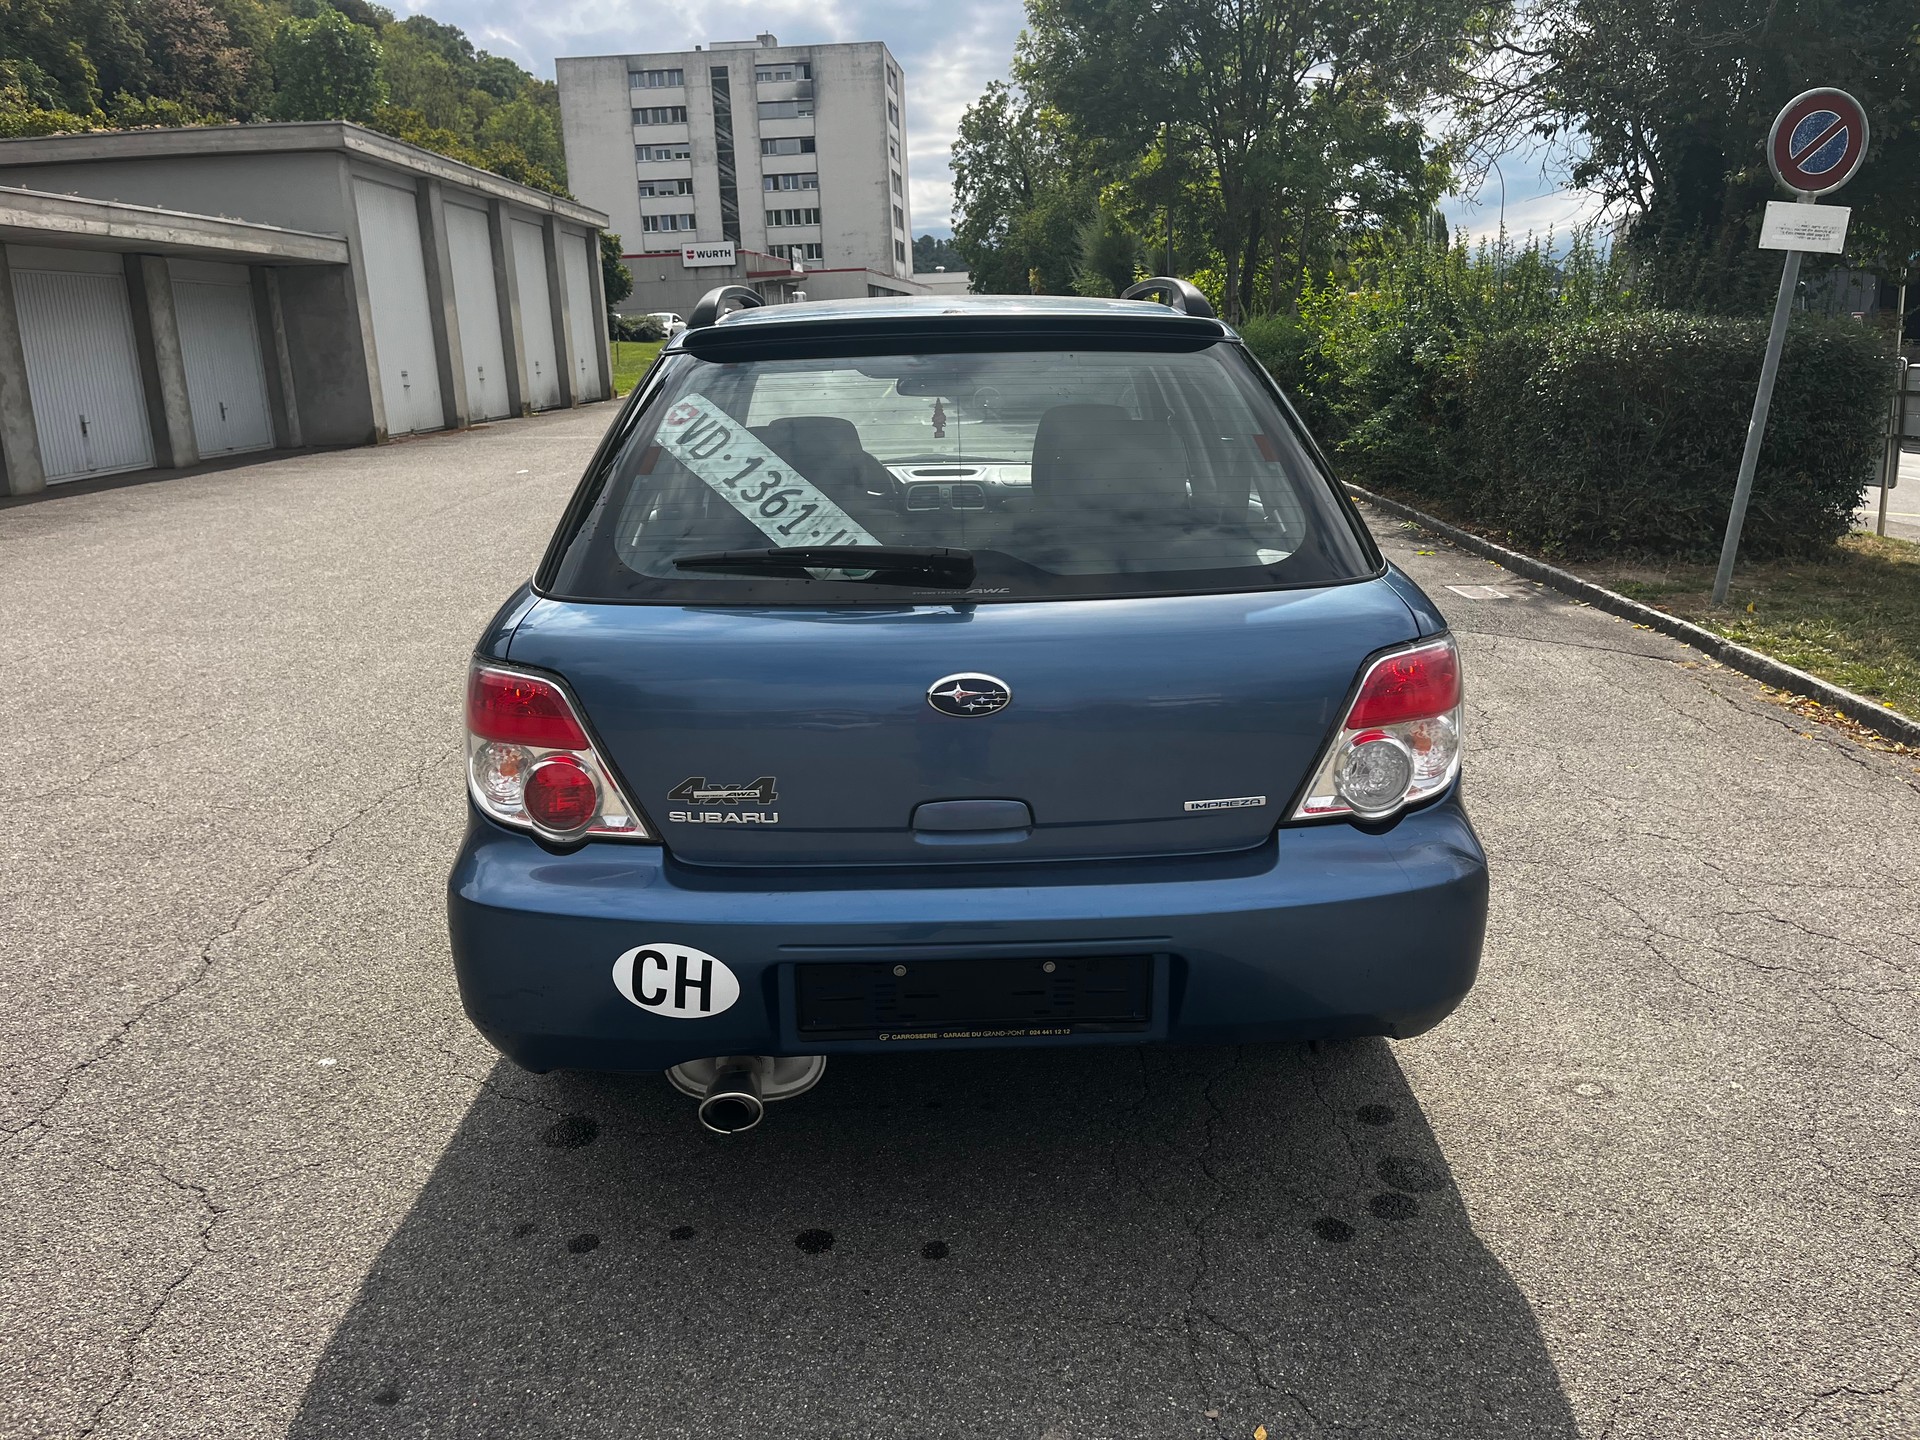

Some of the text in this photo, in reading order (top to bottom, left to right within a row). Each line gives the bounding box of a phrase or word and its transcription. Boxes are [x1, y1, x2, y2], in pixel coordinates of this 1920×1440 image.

[696, 249, 731, 258] WÜRTH
[1191, 798, 1261, 809] IMPREZA
[668, 811, 779, 823] SUBARU
[632, 949, 713, 1012] CH
